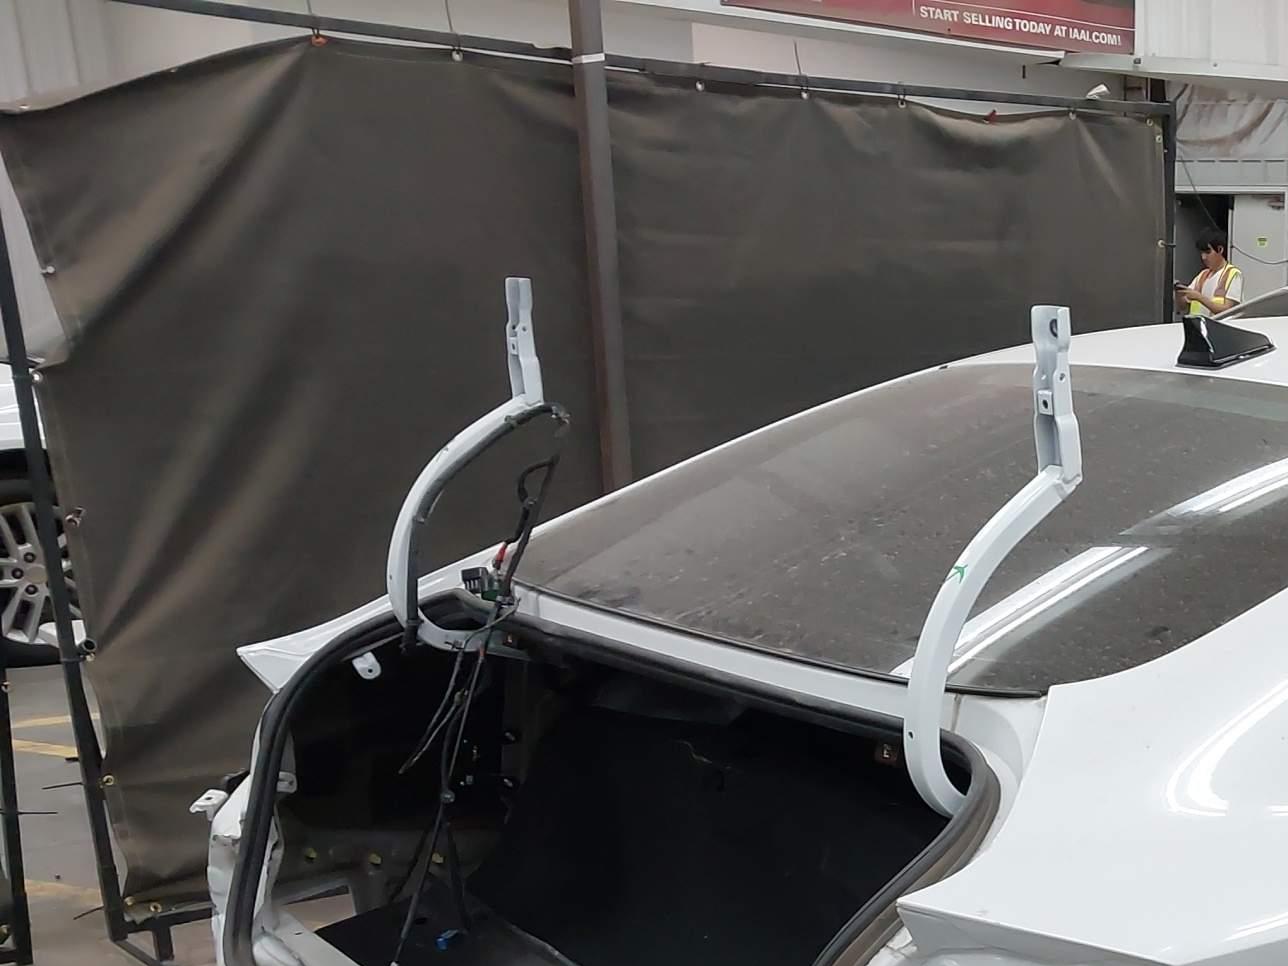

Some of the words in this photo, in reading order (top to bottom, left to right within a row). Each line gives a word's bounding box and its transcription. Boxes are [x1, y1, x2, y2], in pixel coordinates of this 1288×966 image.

[919, 5, 960, 22] START
[962, 11, 1013, 31] SELLING
[1014, 18, 1052, 36] TODAY
[1053, 25, 1068, 38] AT
[1068, 27, 1122, 47] IAAI.COM!
